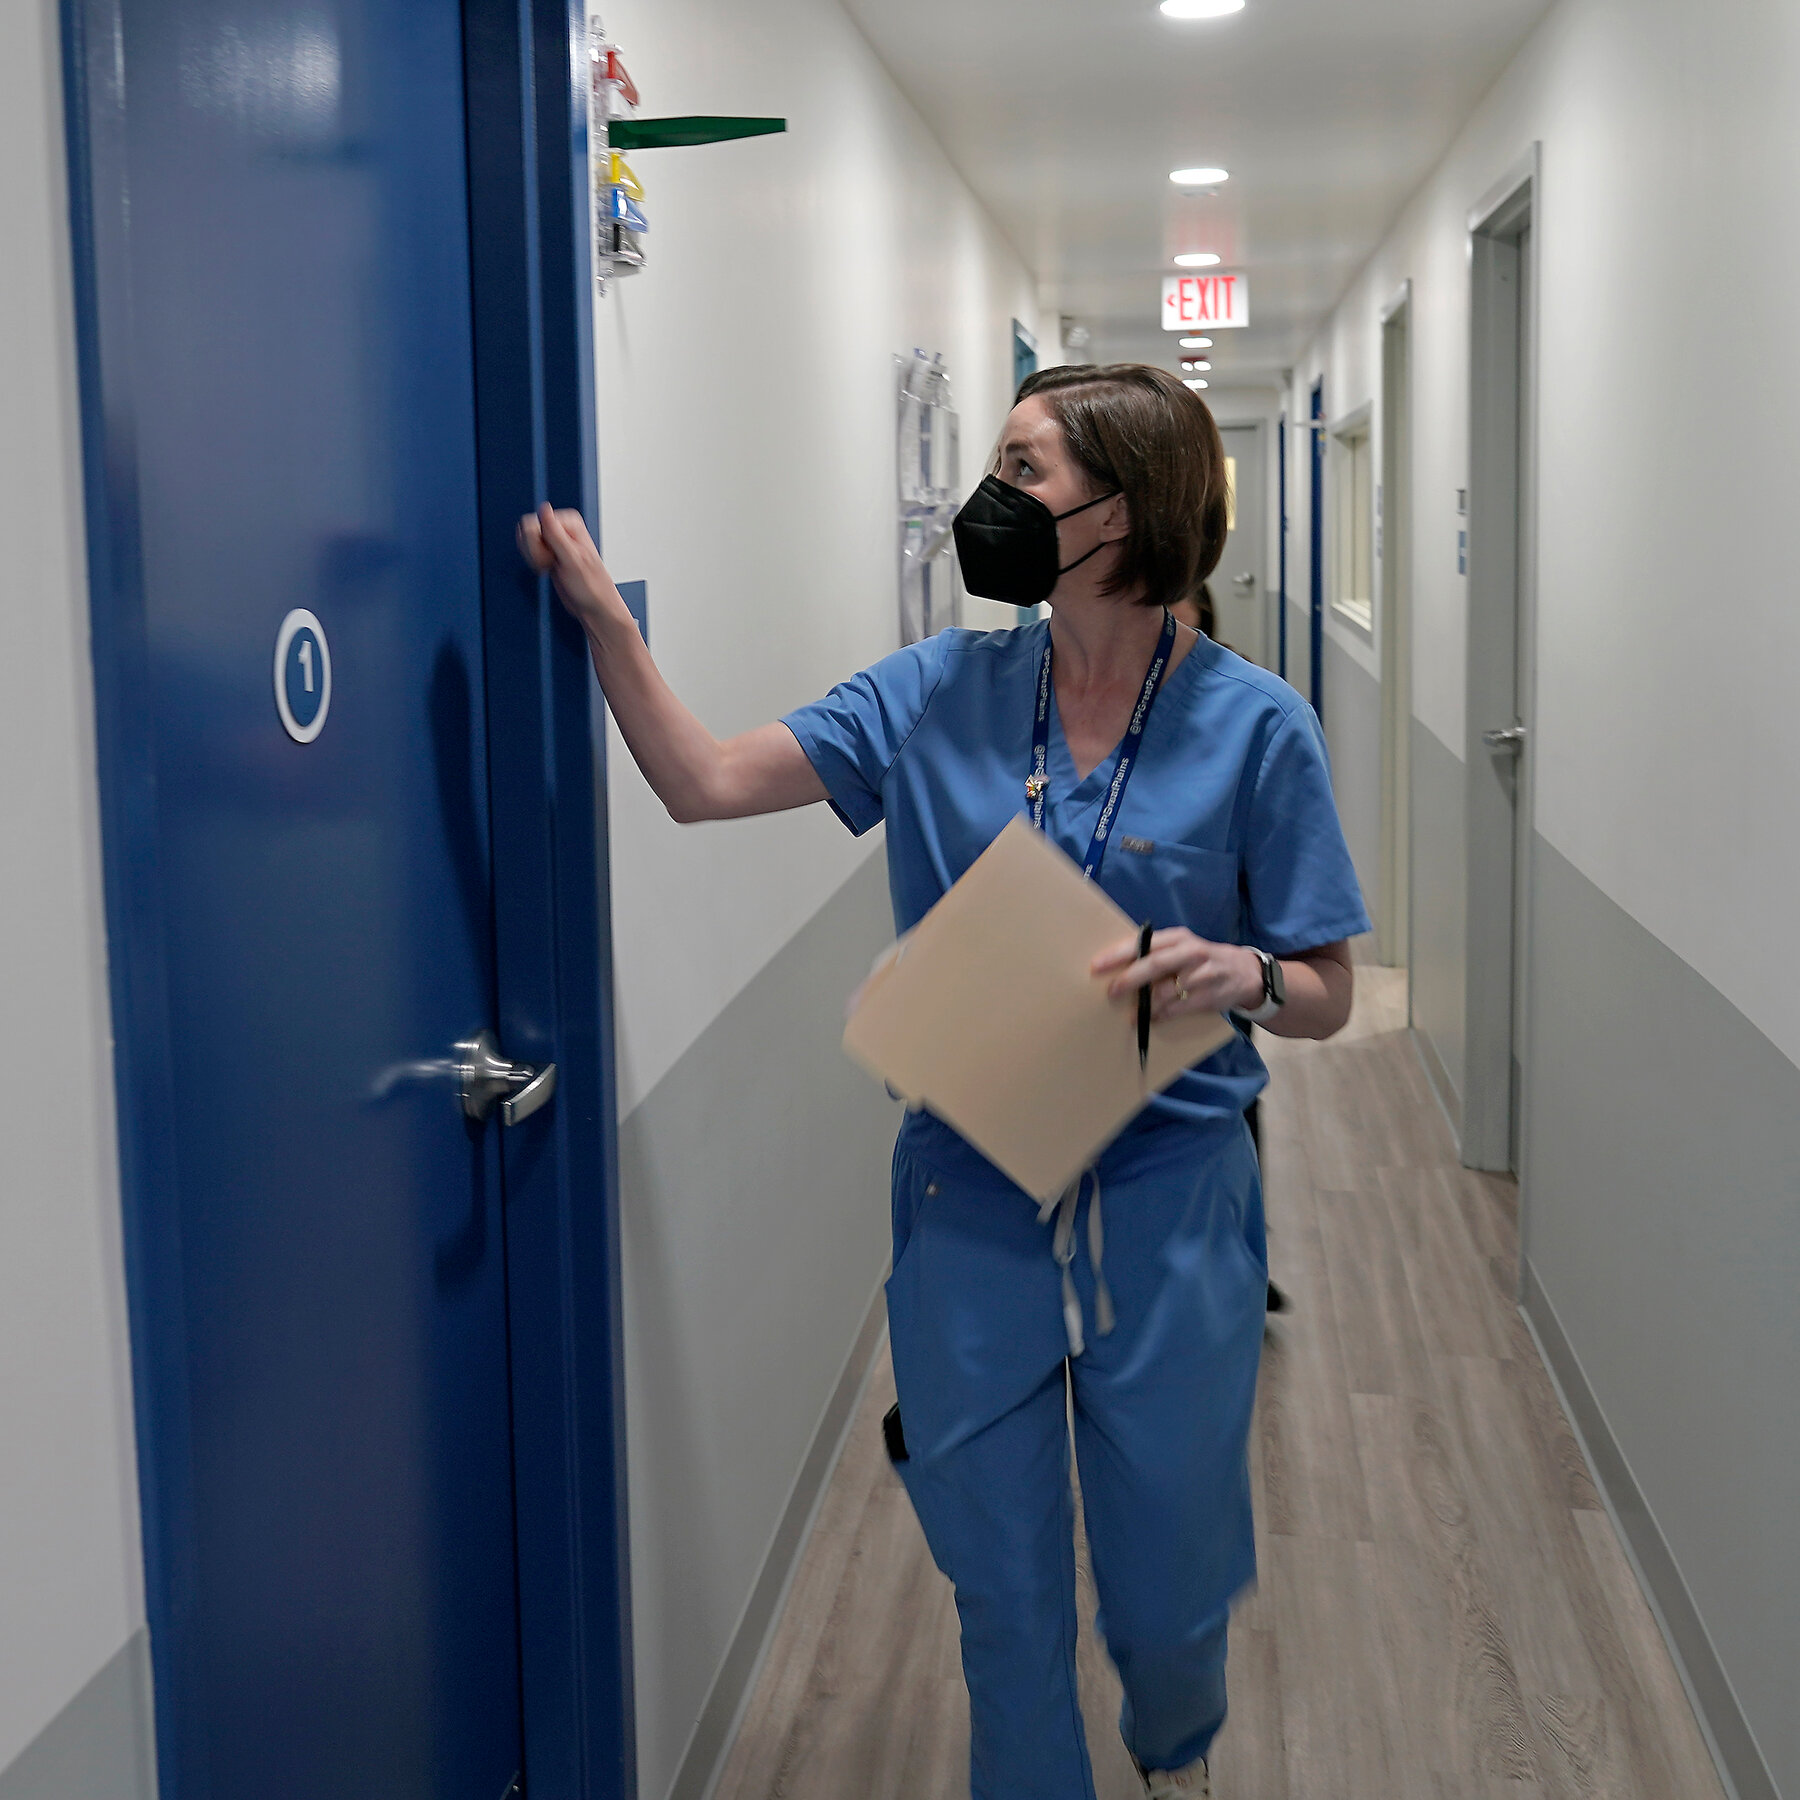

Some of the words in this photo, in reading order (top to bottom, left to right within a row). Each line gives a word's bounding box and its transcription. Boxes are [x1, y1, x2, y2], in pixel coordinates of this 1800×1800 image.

[1178, 276, 1236, 321] EXIT
[298, 640, 314, 692] 1
[1129, 657, 1163, 735] @PPGreatPlains
